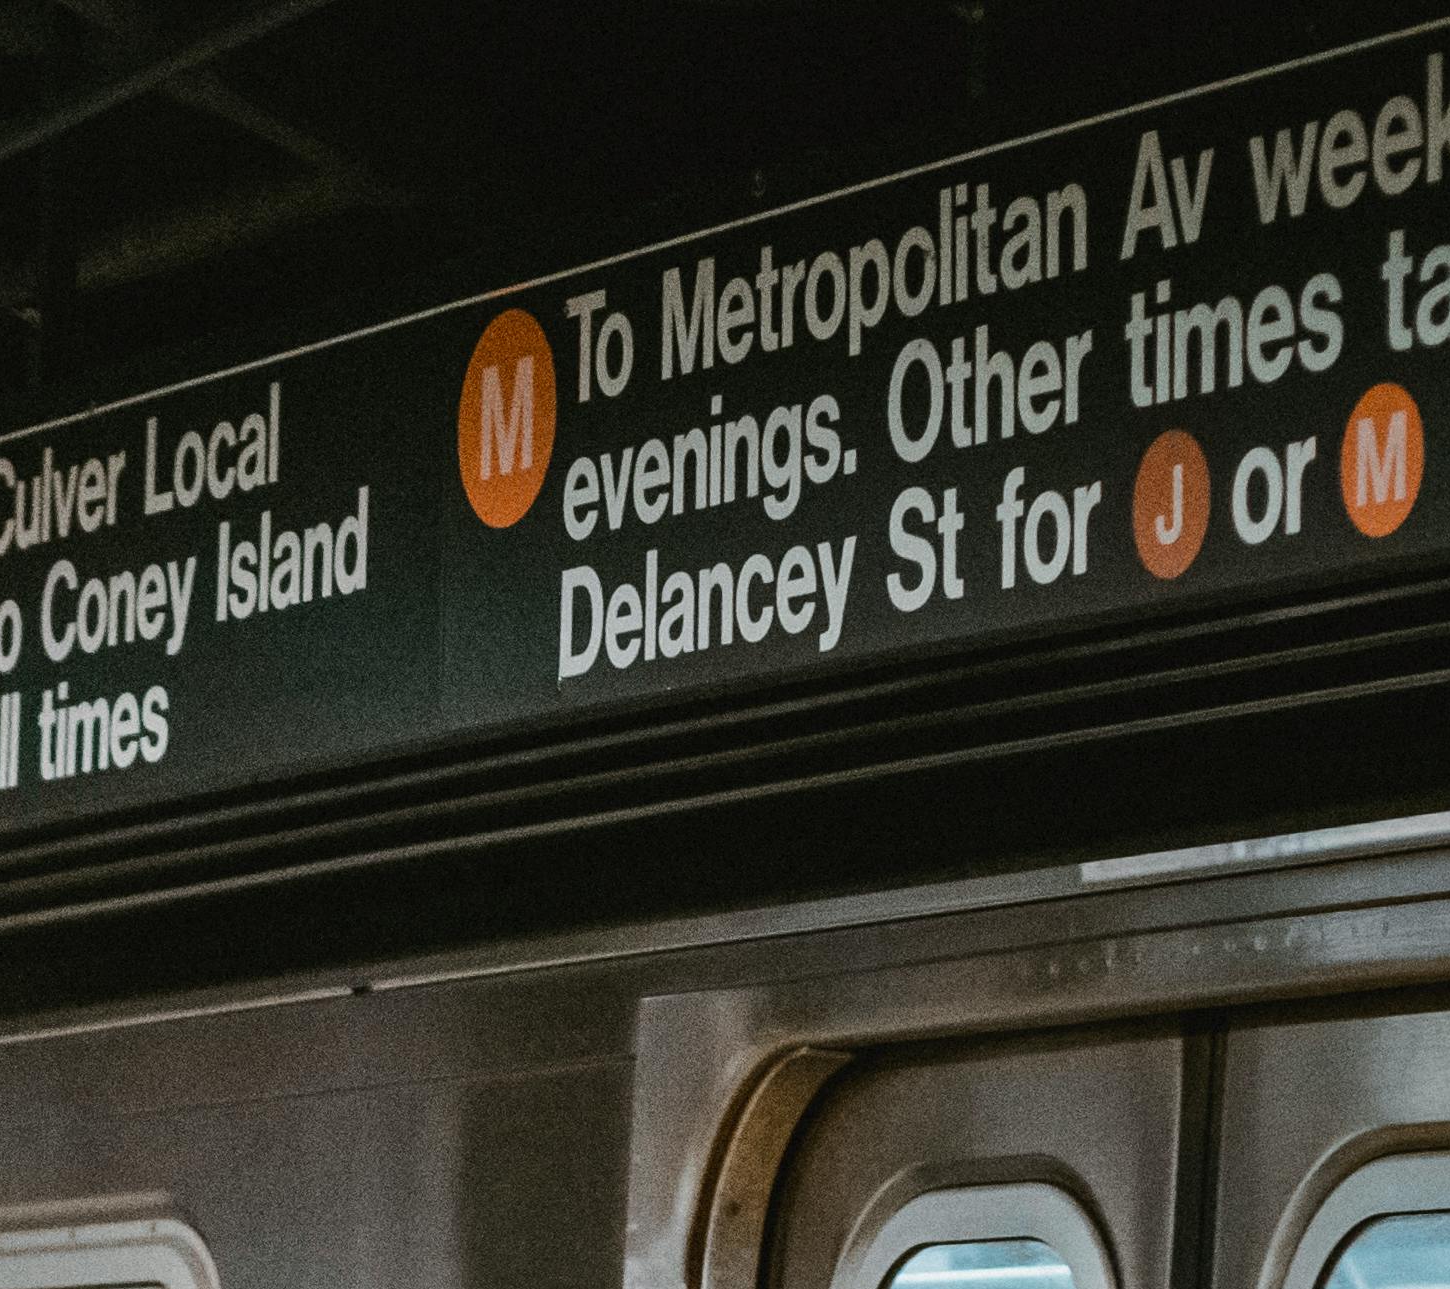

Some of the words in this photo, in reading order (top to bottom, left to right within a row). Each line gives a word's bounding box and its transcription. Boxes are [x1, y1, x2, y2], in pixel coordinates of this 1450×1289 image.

[567, 288, 634, 403] To
[658, 181, 1090, 381] Metropolitan
[1120, 130, 1215, 260] Av
[143, 382, 281, 515] Local
[562, 394, 858, 542] evenings.
[887, 325, 1093, 464] Other
[1124, 273, 1345, 408] times
[40, 556, 198, 663] Coney
[213, 485, 370, 622] Island
[557, 534, 858, 681] Delancey
[885, 486, 966, 613] St
[995, 468, 1103, 590] for
[1231, 437, 1318, 546] or
[38, 681, 171, 781] times
